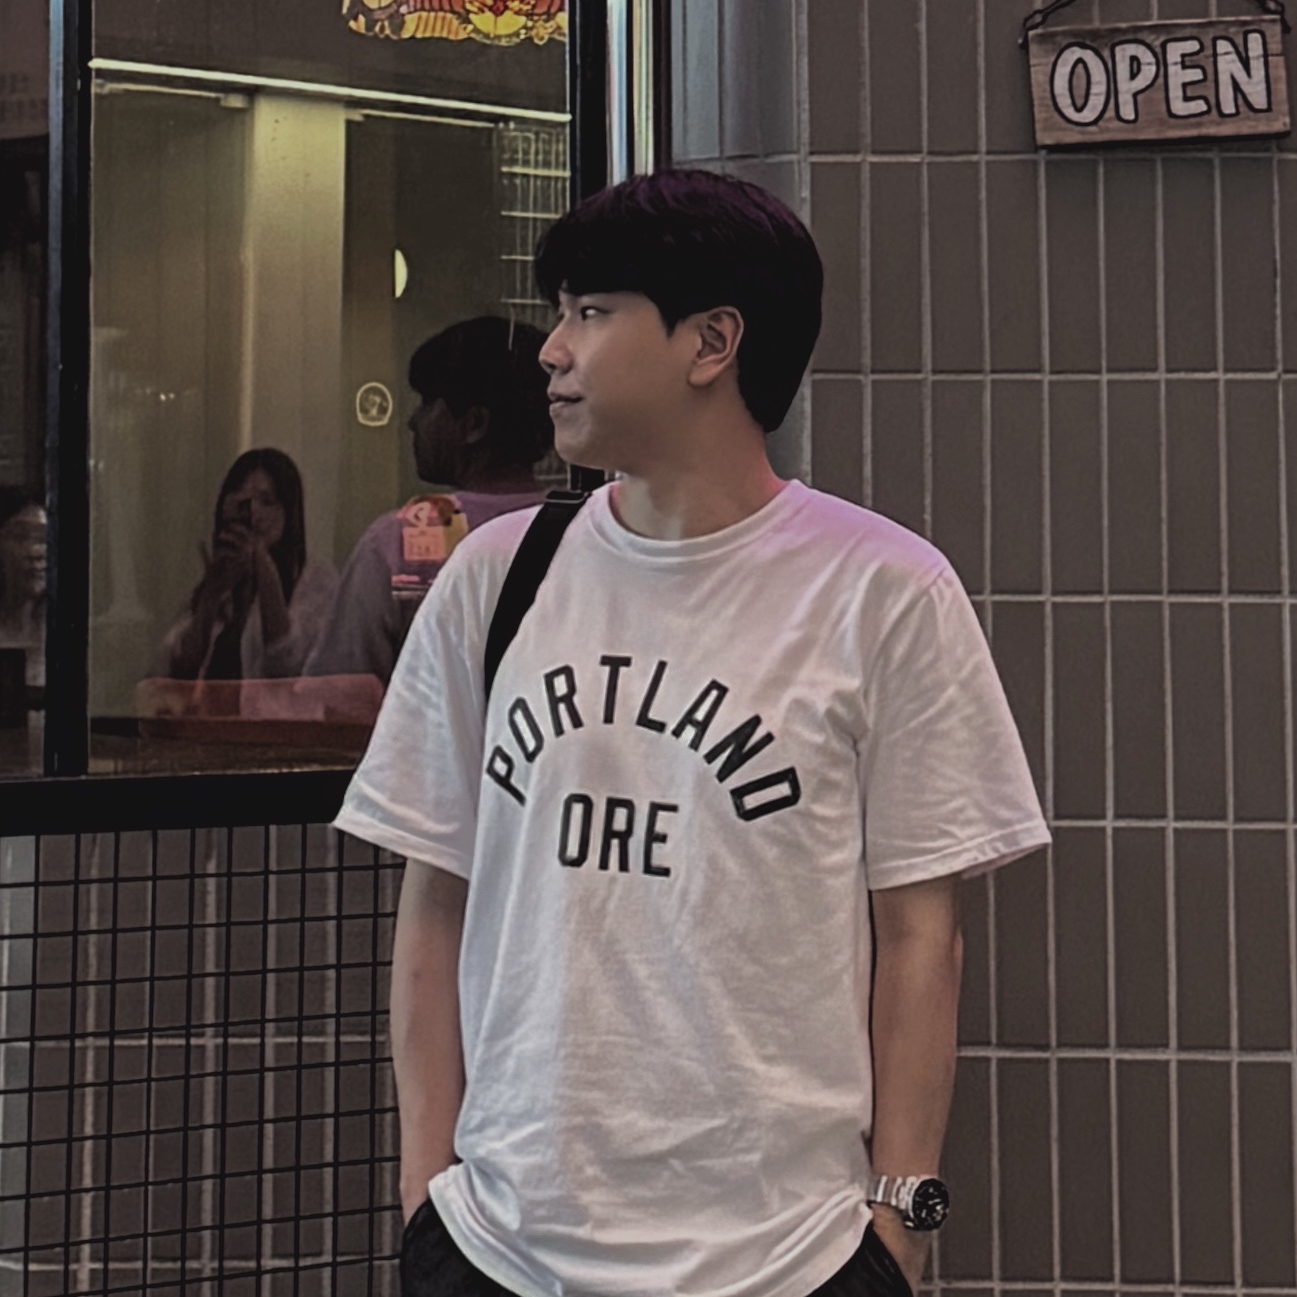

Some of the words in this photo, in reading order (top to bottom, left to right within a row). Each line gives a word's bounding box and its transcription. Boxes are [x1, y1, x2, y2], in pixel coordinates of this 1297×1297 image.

[1050, 29, 1272, 128] OPEN
[486, 654, 802, 823] PORTLAND
[557, 792, 680, 878] ORE
